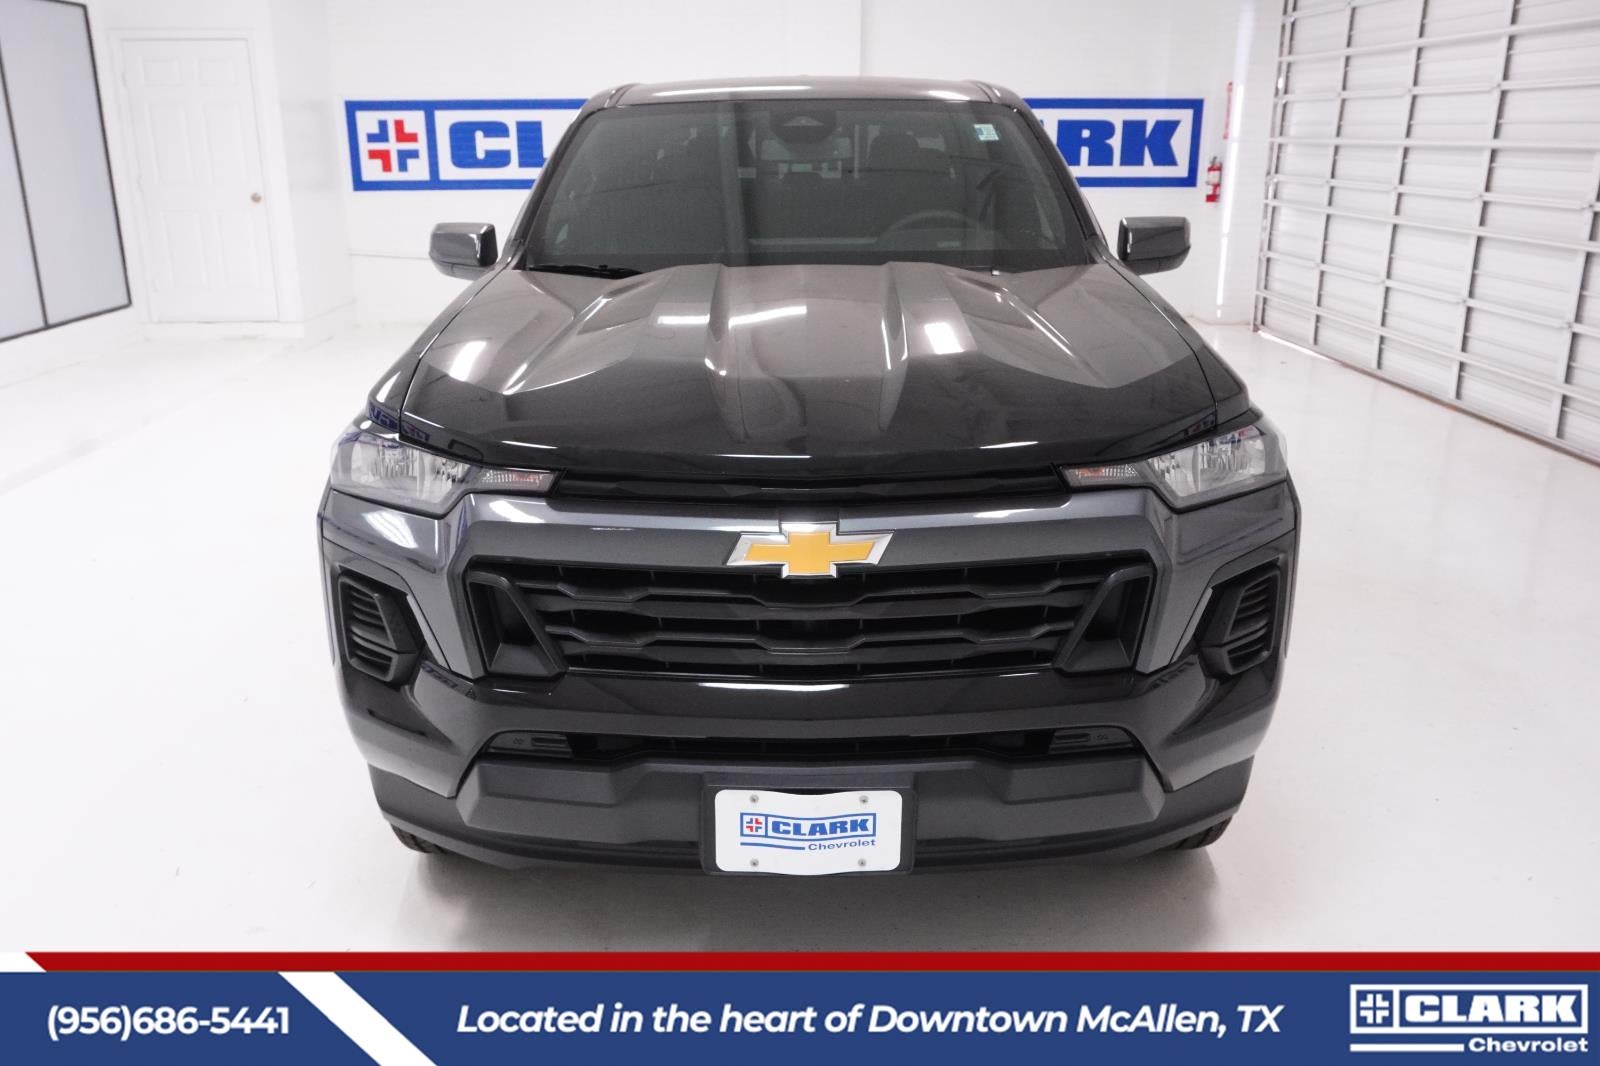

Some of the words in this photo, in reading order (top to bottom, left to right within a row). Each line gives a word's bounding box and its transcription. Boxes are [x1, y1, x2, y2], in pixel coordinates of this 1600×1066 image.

[1056, 119, 1181, 167] RK
[771, 818, 870, 837] CLARK
[808, 839, 876, 851] Chevrolet
